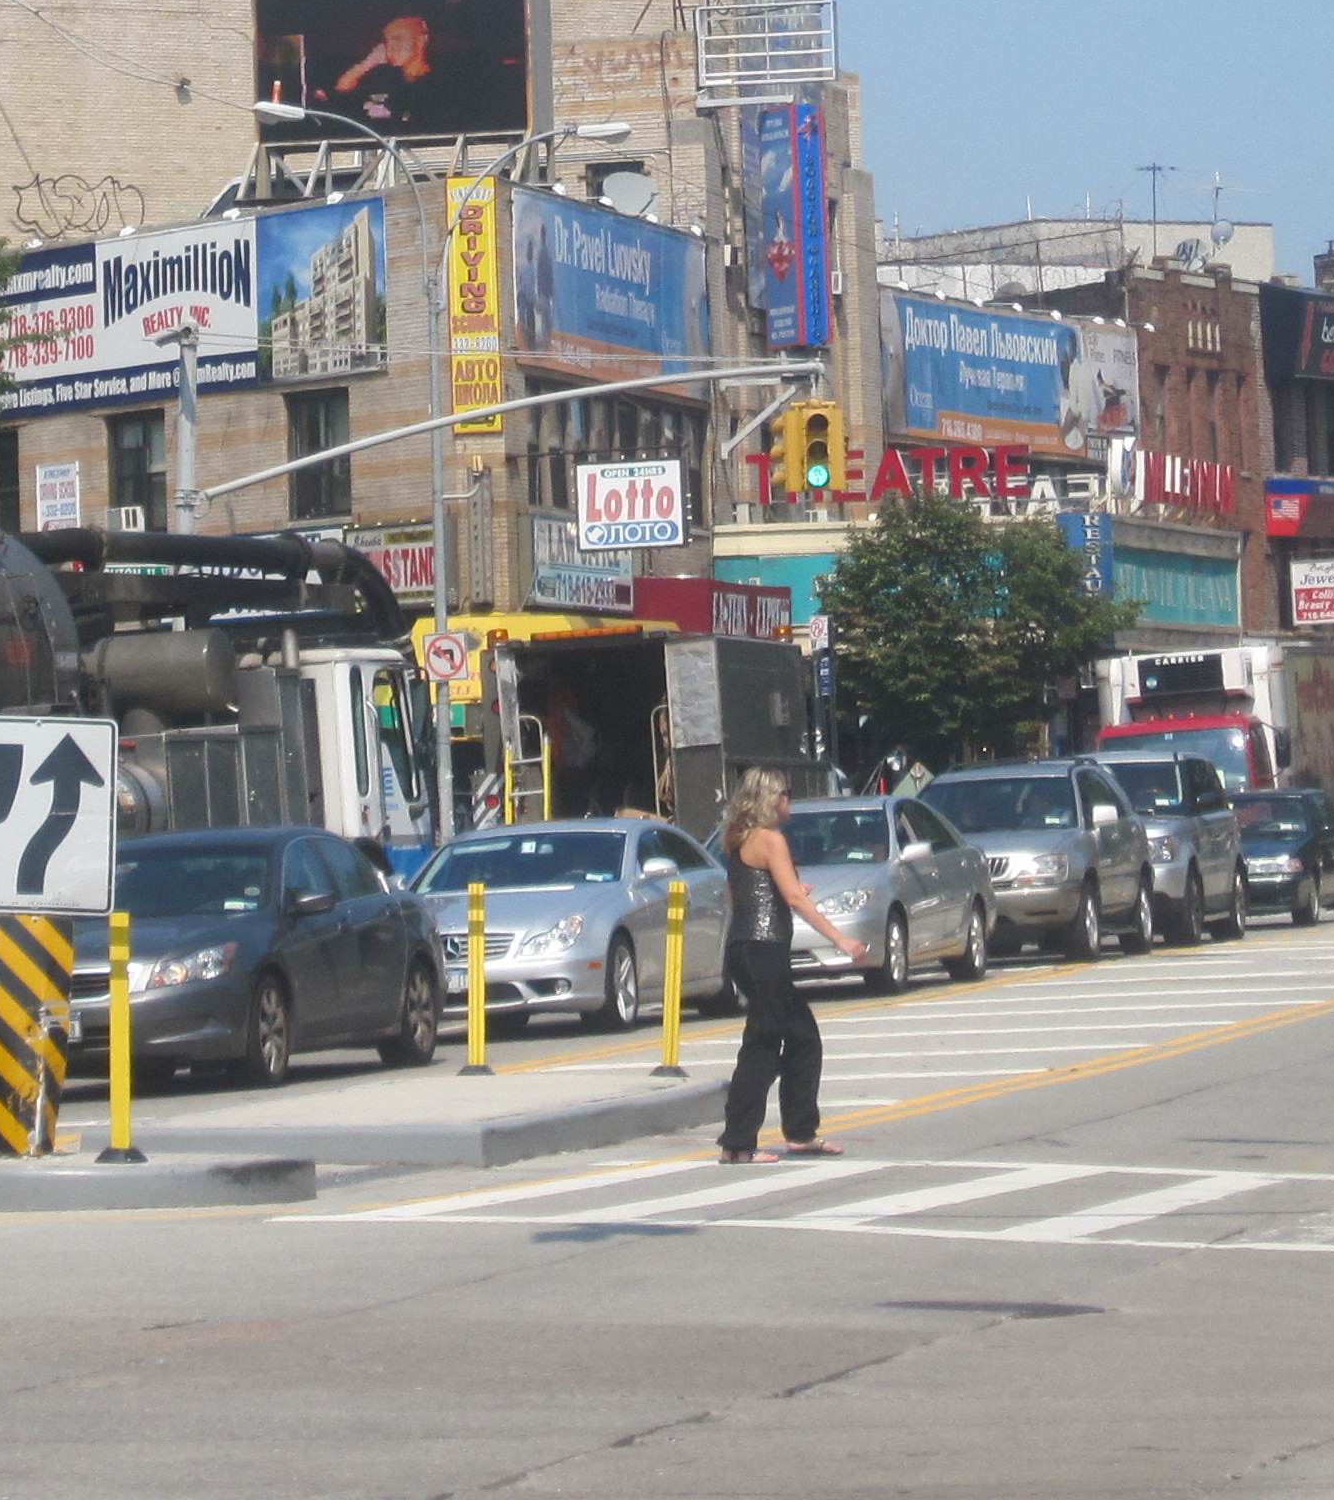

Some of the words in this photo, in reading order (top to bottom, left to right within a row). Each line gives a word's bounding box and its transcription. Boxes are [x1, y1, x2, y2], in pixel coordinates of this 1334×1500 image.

[458, 205, 487, 314] DRIVING
[554, 215, 571, 263] Dr.
[573, 220, 605, 275] Pavel
[608, 230, 651, 297] Lvovsky
[8, 304, 95, 337] 718-376-9300
[141, 305, 184, 338] REALTY
[452, 314, 496, 334] SCHOOL
[905, 306, 948, 357] Доктор
[950, 314, 988, 358] Павел
[990, 323, 1058, 367] Львовский
[8, 334, 95, 370] 718-339-7100
[455, 359, 498, 382] АВТО
[19, 387, 56, 409] Listings,
[56, 383, 73, 400] Five
[74, 380, 92, 399] Star
[94, 377, 129, 398] Service,
[130, 377, 147, 393] and
[148, 371, 171, 388] More
[455, 382, 498, 405] ШКОЛА
[604, 468, 630, 479] OPEN
[633, 465, 664, 477] 24HRS
[746, 444, 1032, 505] TEATRE
[586, 473, 675, 523] Lotto
[608, 522, 673, 544] ЛОТО
[1155, 654, 1204, 667] CARRIER
